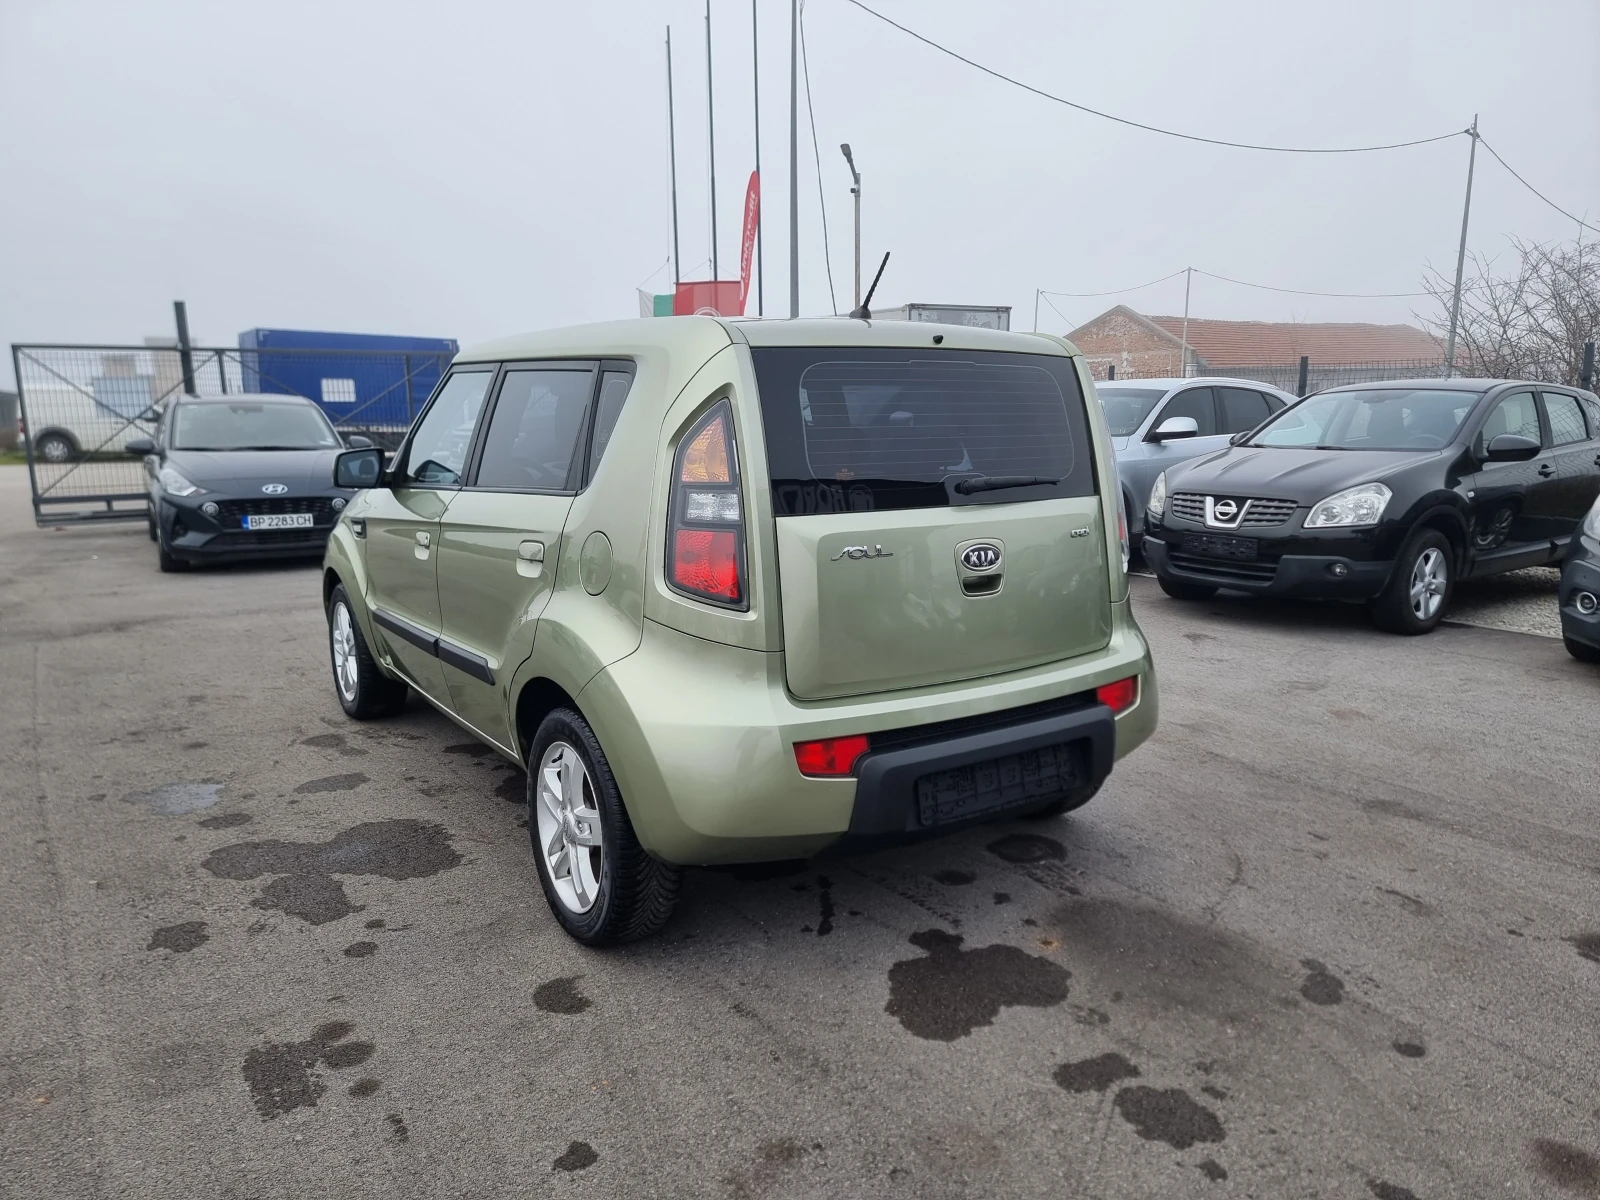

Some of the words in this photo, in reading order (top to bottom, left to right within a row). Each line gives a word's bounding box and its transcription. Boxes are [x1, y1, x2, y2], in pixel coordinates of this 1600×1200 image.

[250, 516, 266, 528] BP
[268, 515, 295, 527] 2283
[296, 515, 312, 526] CH
[968, 550, 996, 567] KIA
